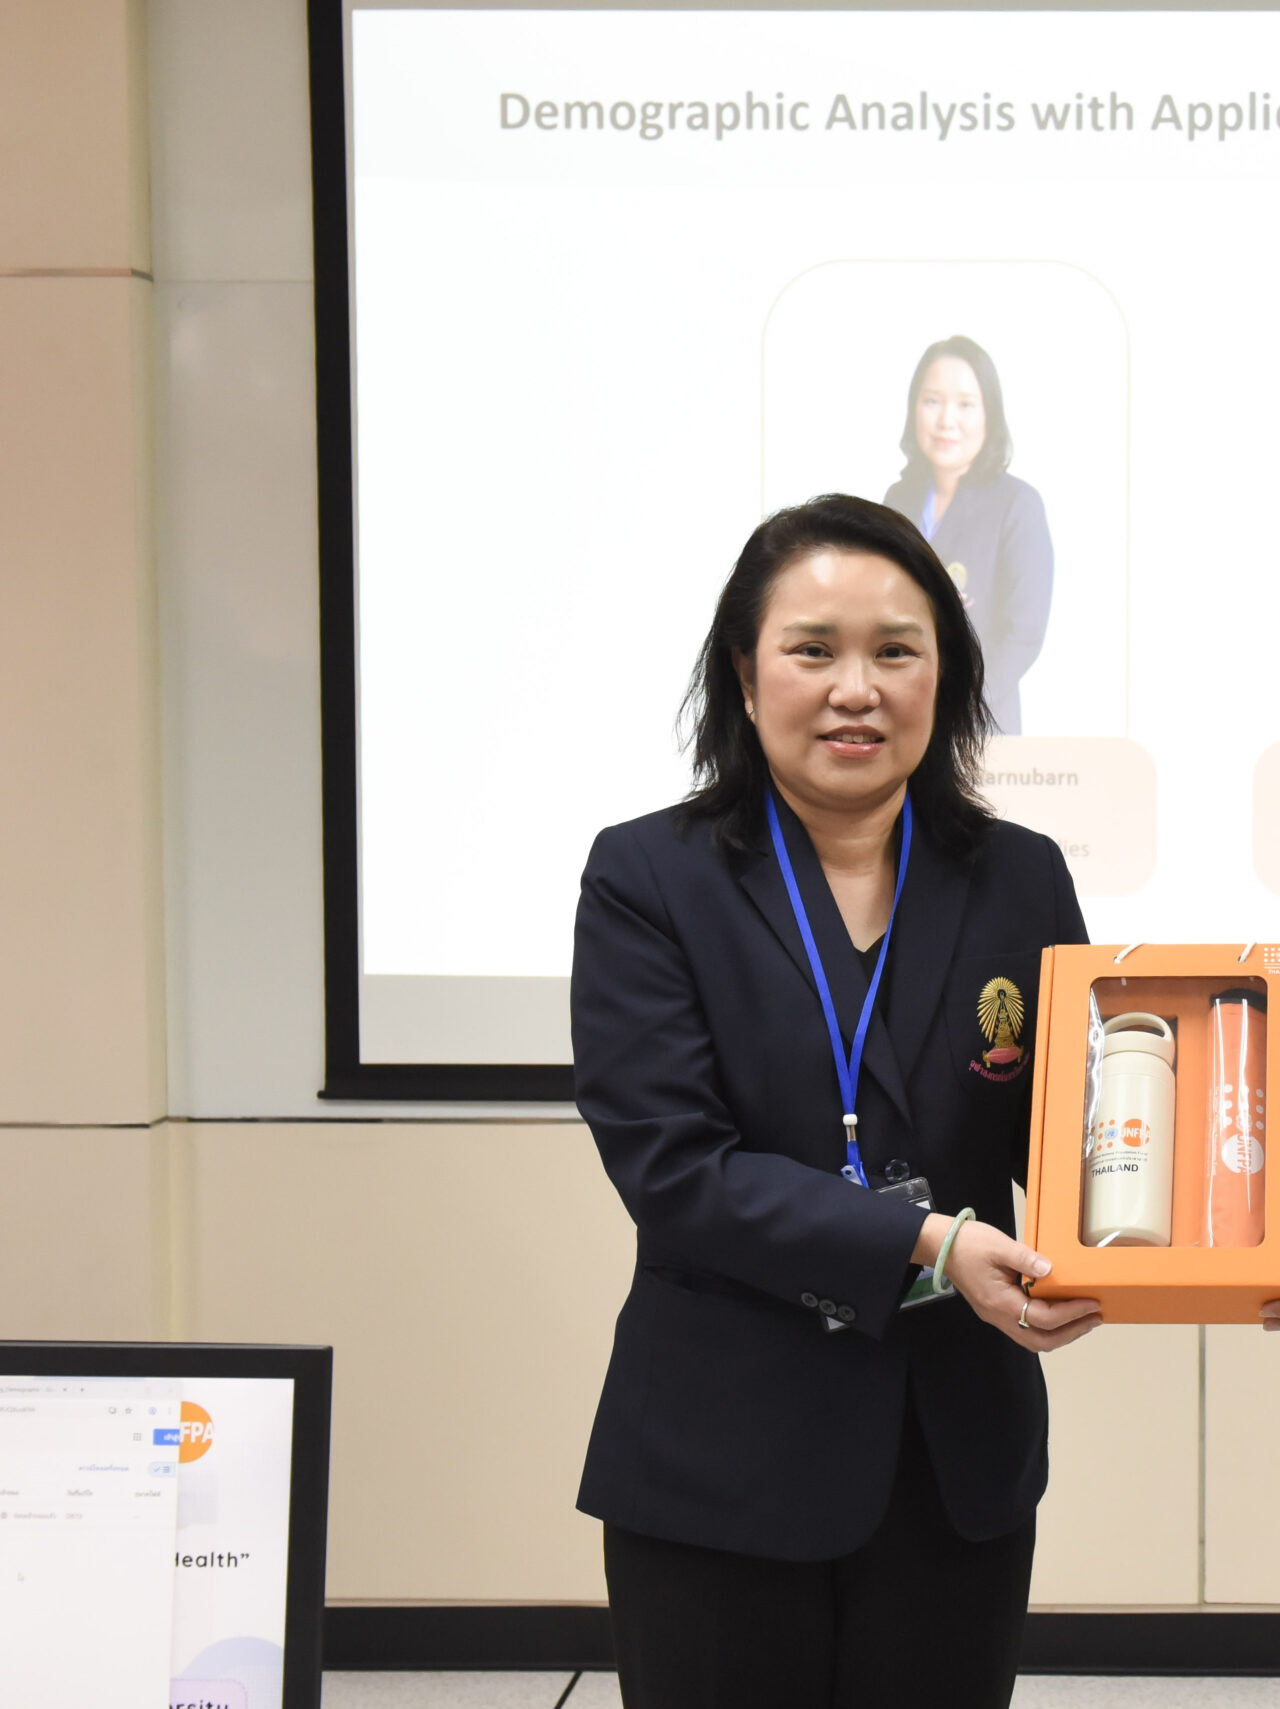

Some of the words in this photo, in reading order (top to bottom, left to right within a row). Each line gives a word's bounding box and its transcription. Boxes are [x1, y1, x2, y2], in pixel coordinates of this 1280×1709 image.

[499, 91, 810, 142] Demographic
[825, 91, 1016, 142] Analysis
[1031, 91, 1134, 133] with
[978, 767, 1079, 786] arnubarn
[1091, 1163, 1140, 1178] THAILAND
[180, 1421, 215, 1443] FPA
